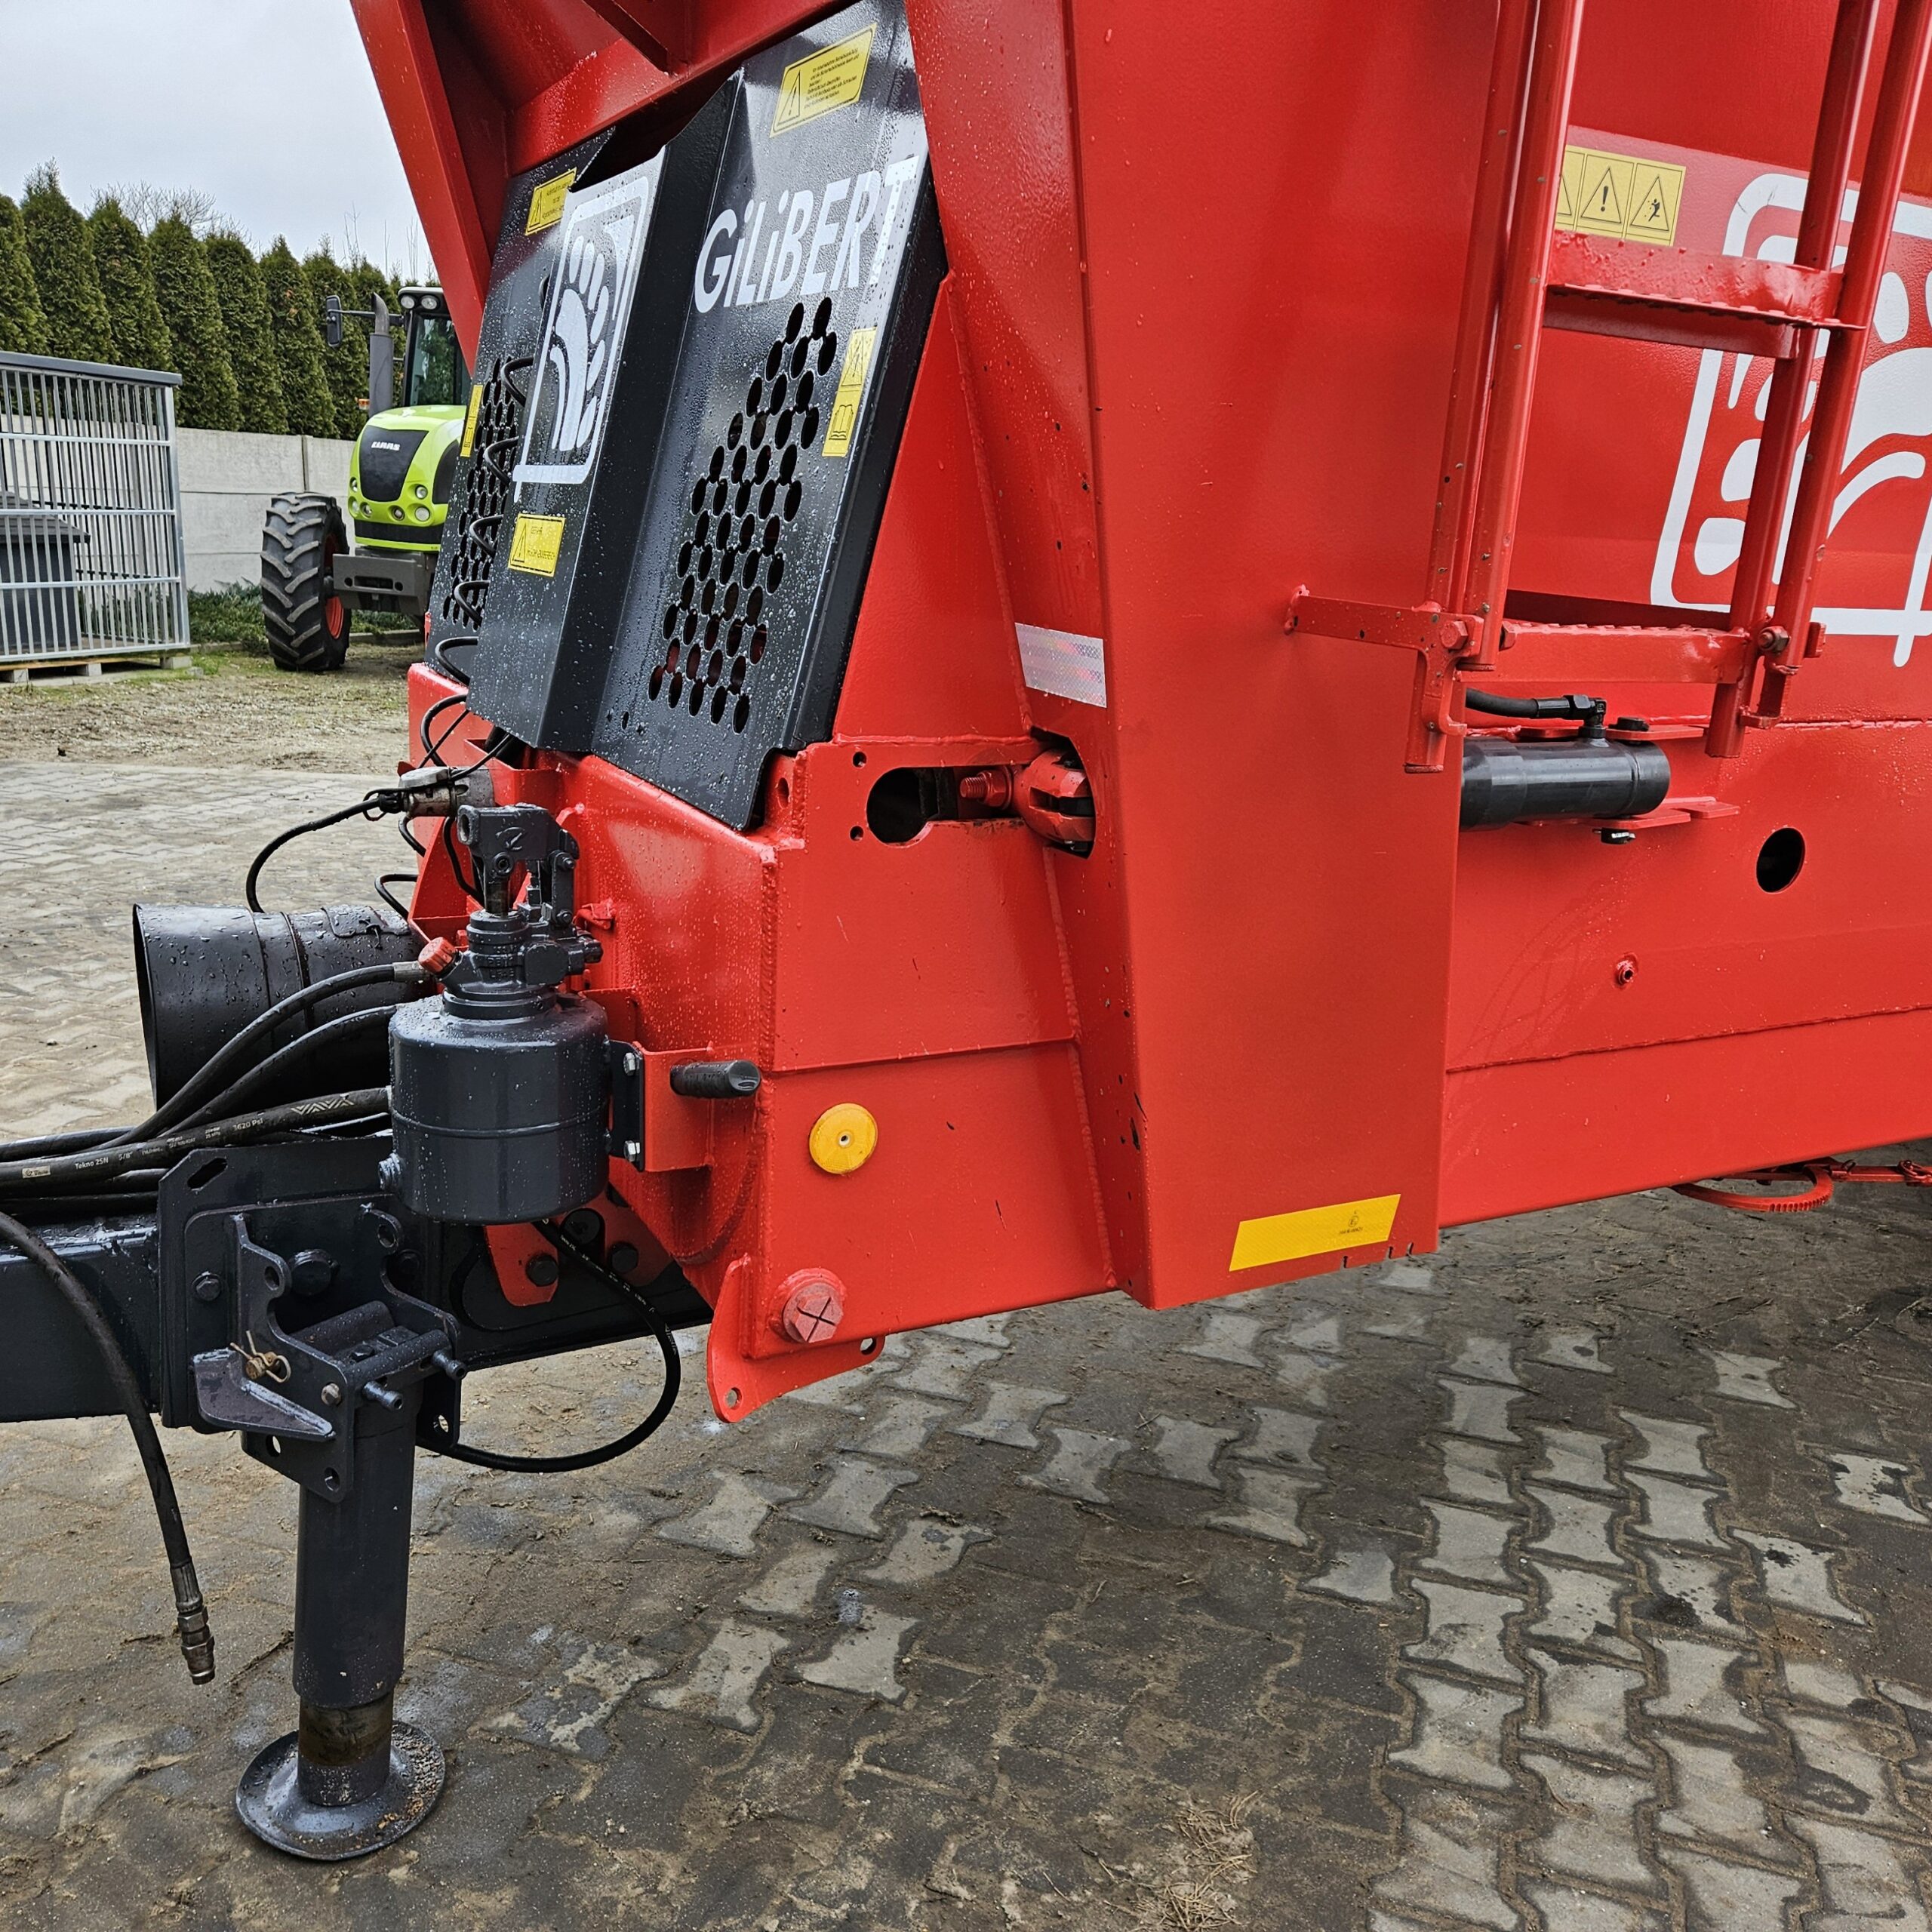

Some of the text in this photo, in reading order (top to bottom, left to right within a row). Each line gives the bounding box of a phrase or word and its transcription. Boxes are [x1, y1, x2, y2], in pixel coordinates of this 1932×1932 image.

[371, 441, 401, 451] CLAAS
[75, 1161, 94, 1170] Tekno
[95, 1156, 109, 1166] 2SN
